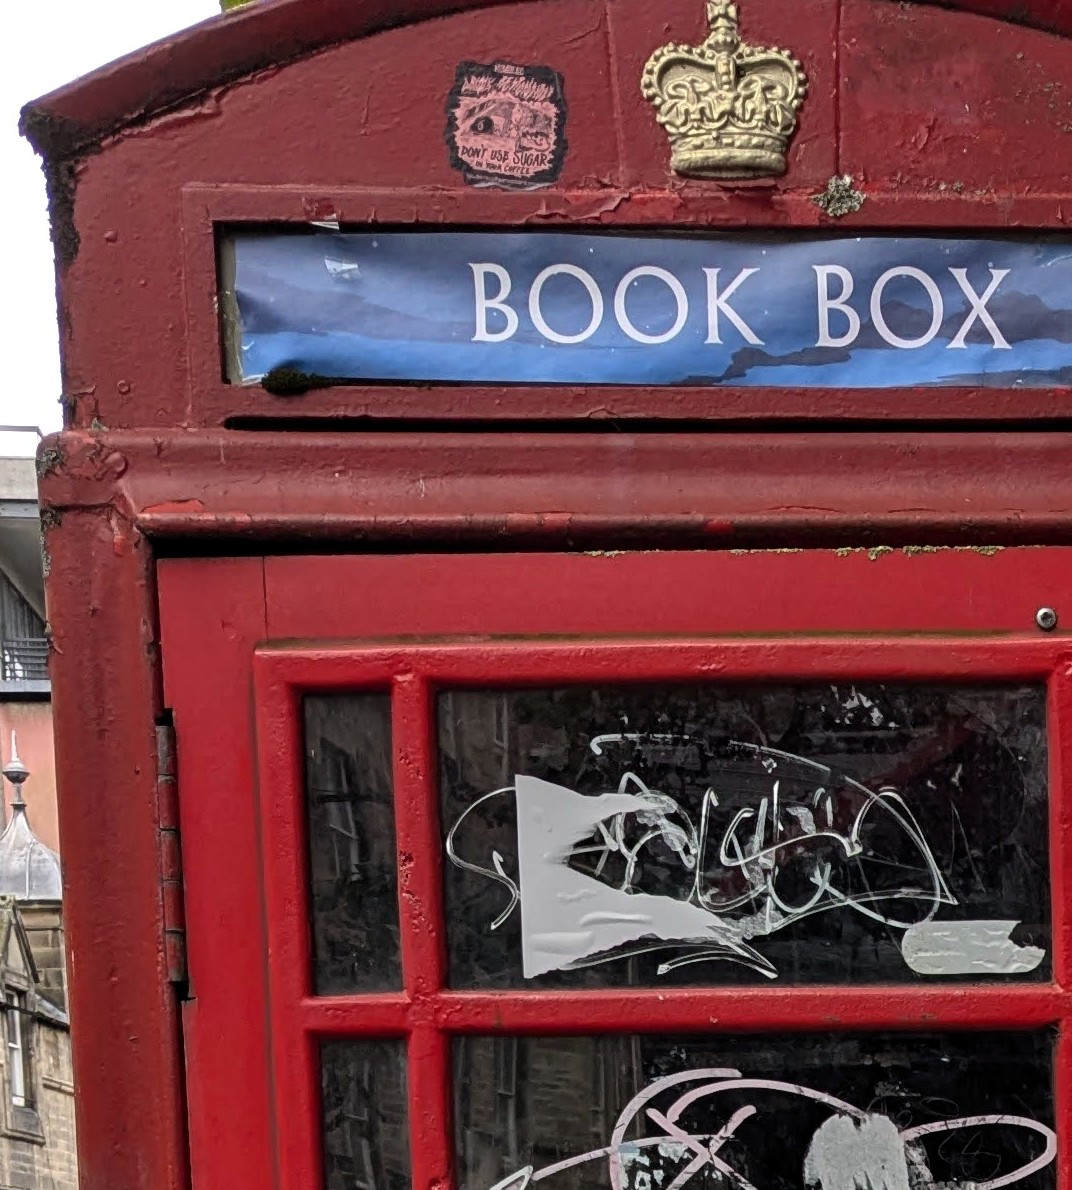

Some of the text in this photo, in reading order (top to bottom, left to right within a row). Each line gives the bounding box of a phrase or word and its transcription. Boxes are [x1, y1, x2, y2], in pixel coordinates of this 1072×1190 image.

[461, 143, 547, 167] DON'T USE SUGAR
[504, 163, 531, 175] COFFEE
[468, 262, 1012, 350] BOOK BOX
